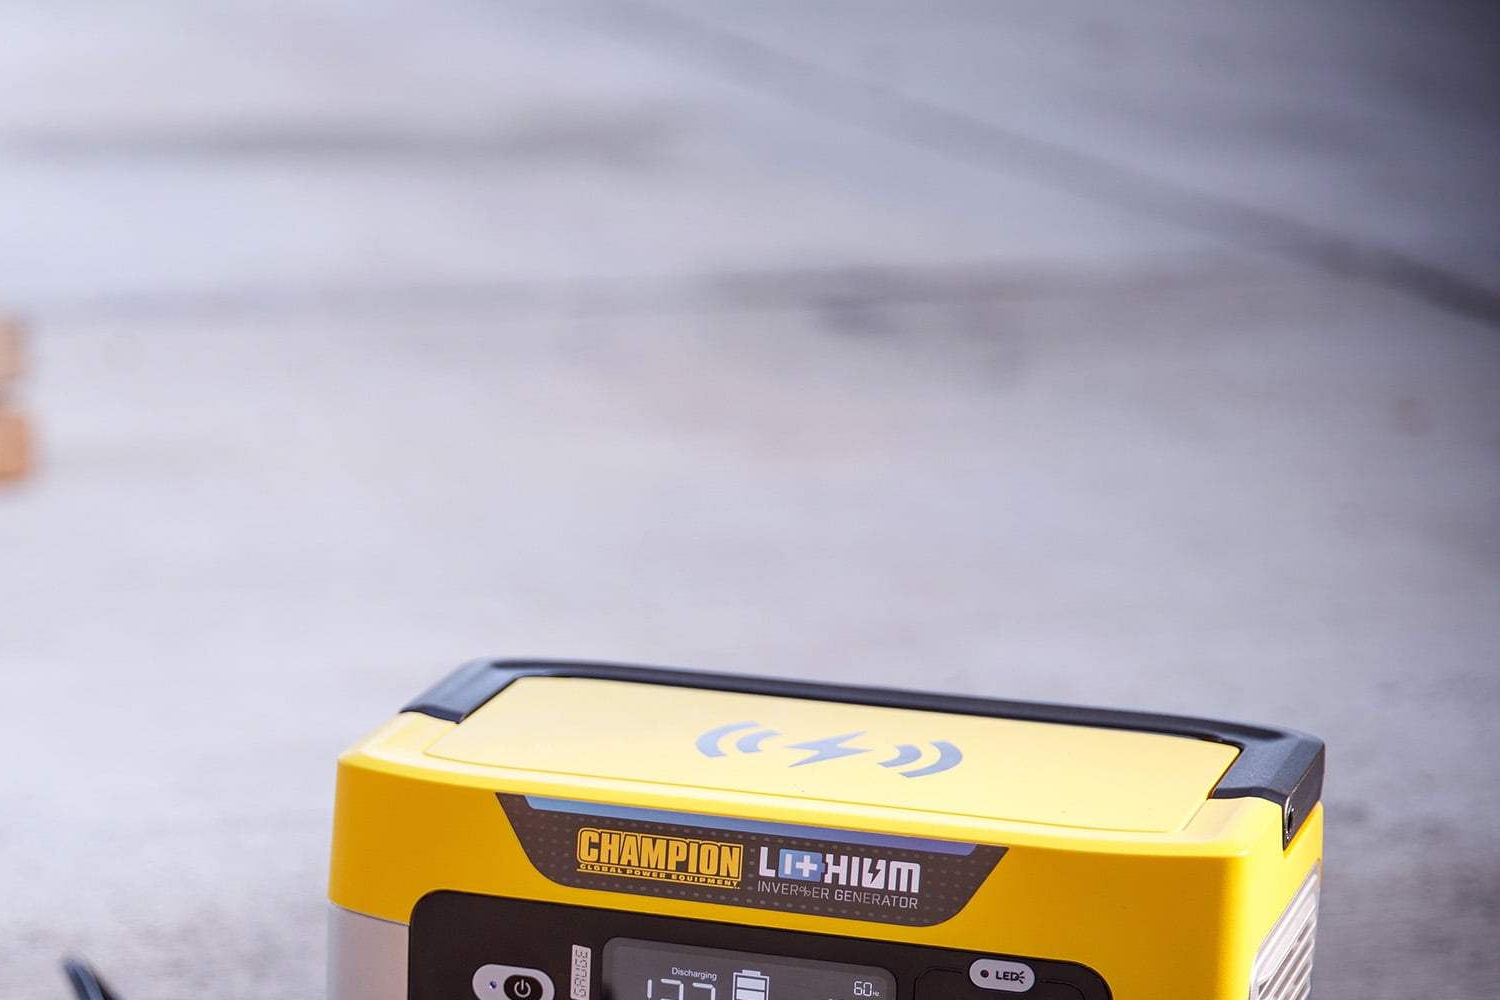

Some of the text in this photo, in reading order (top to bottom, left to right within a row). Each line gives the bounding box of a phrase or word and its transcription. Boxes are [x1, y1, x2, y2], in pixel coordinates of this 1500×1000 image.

[580, 829, 742, 879] CHAMPION
[579, 863, 739, 887] GLOBAL POWER EQUIPMENT
[834, 889, 919, 910] GENERATOR
[573, 948, 589, 999] GAUGE
[671, 967, 718, 982] Discharging
[995, 970, 1020, 982] LED
